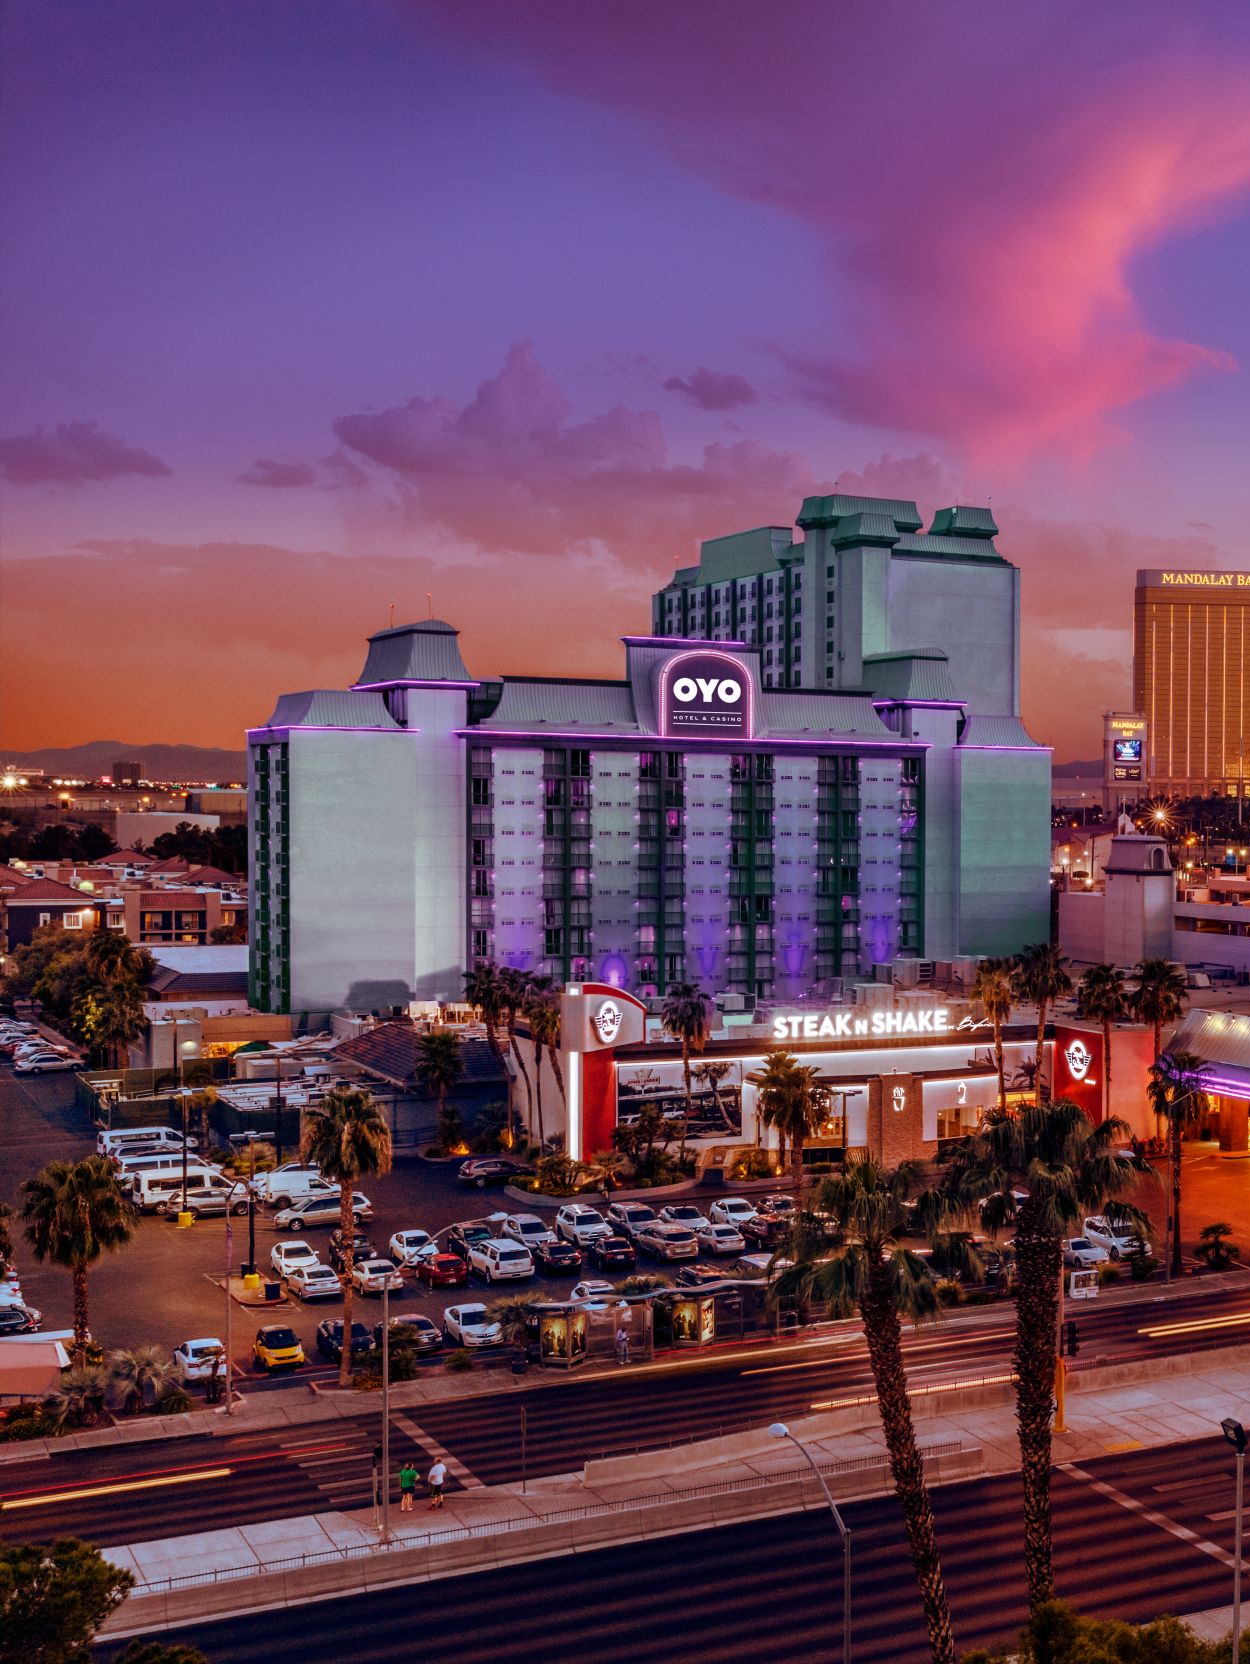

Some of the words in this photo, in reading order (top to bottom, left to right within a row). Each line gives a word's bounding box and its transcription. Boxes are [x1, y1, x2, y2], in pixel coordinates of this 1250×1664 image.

[1162, 573, 1234, 586] MANDALAY
[673, 677, 742, 704] OYO
[1112, 721, 1144, 729] MANDALAY
[774, 1014, 852, 1038] STEAK
[854, 1019, 868, 1034] N
[872, 1009, 949, 1034] SHAKE
